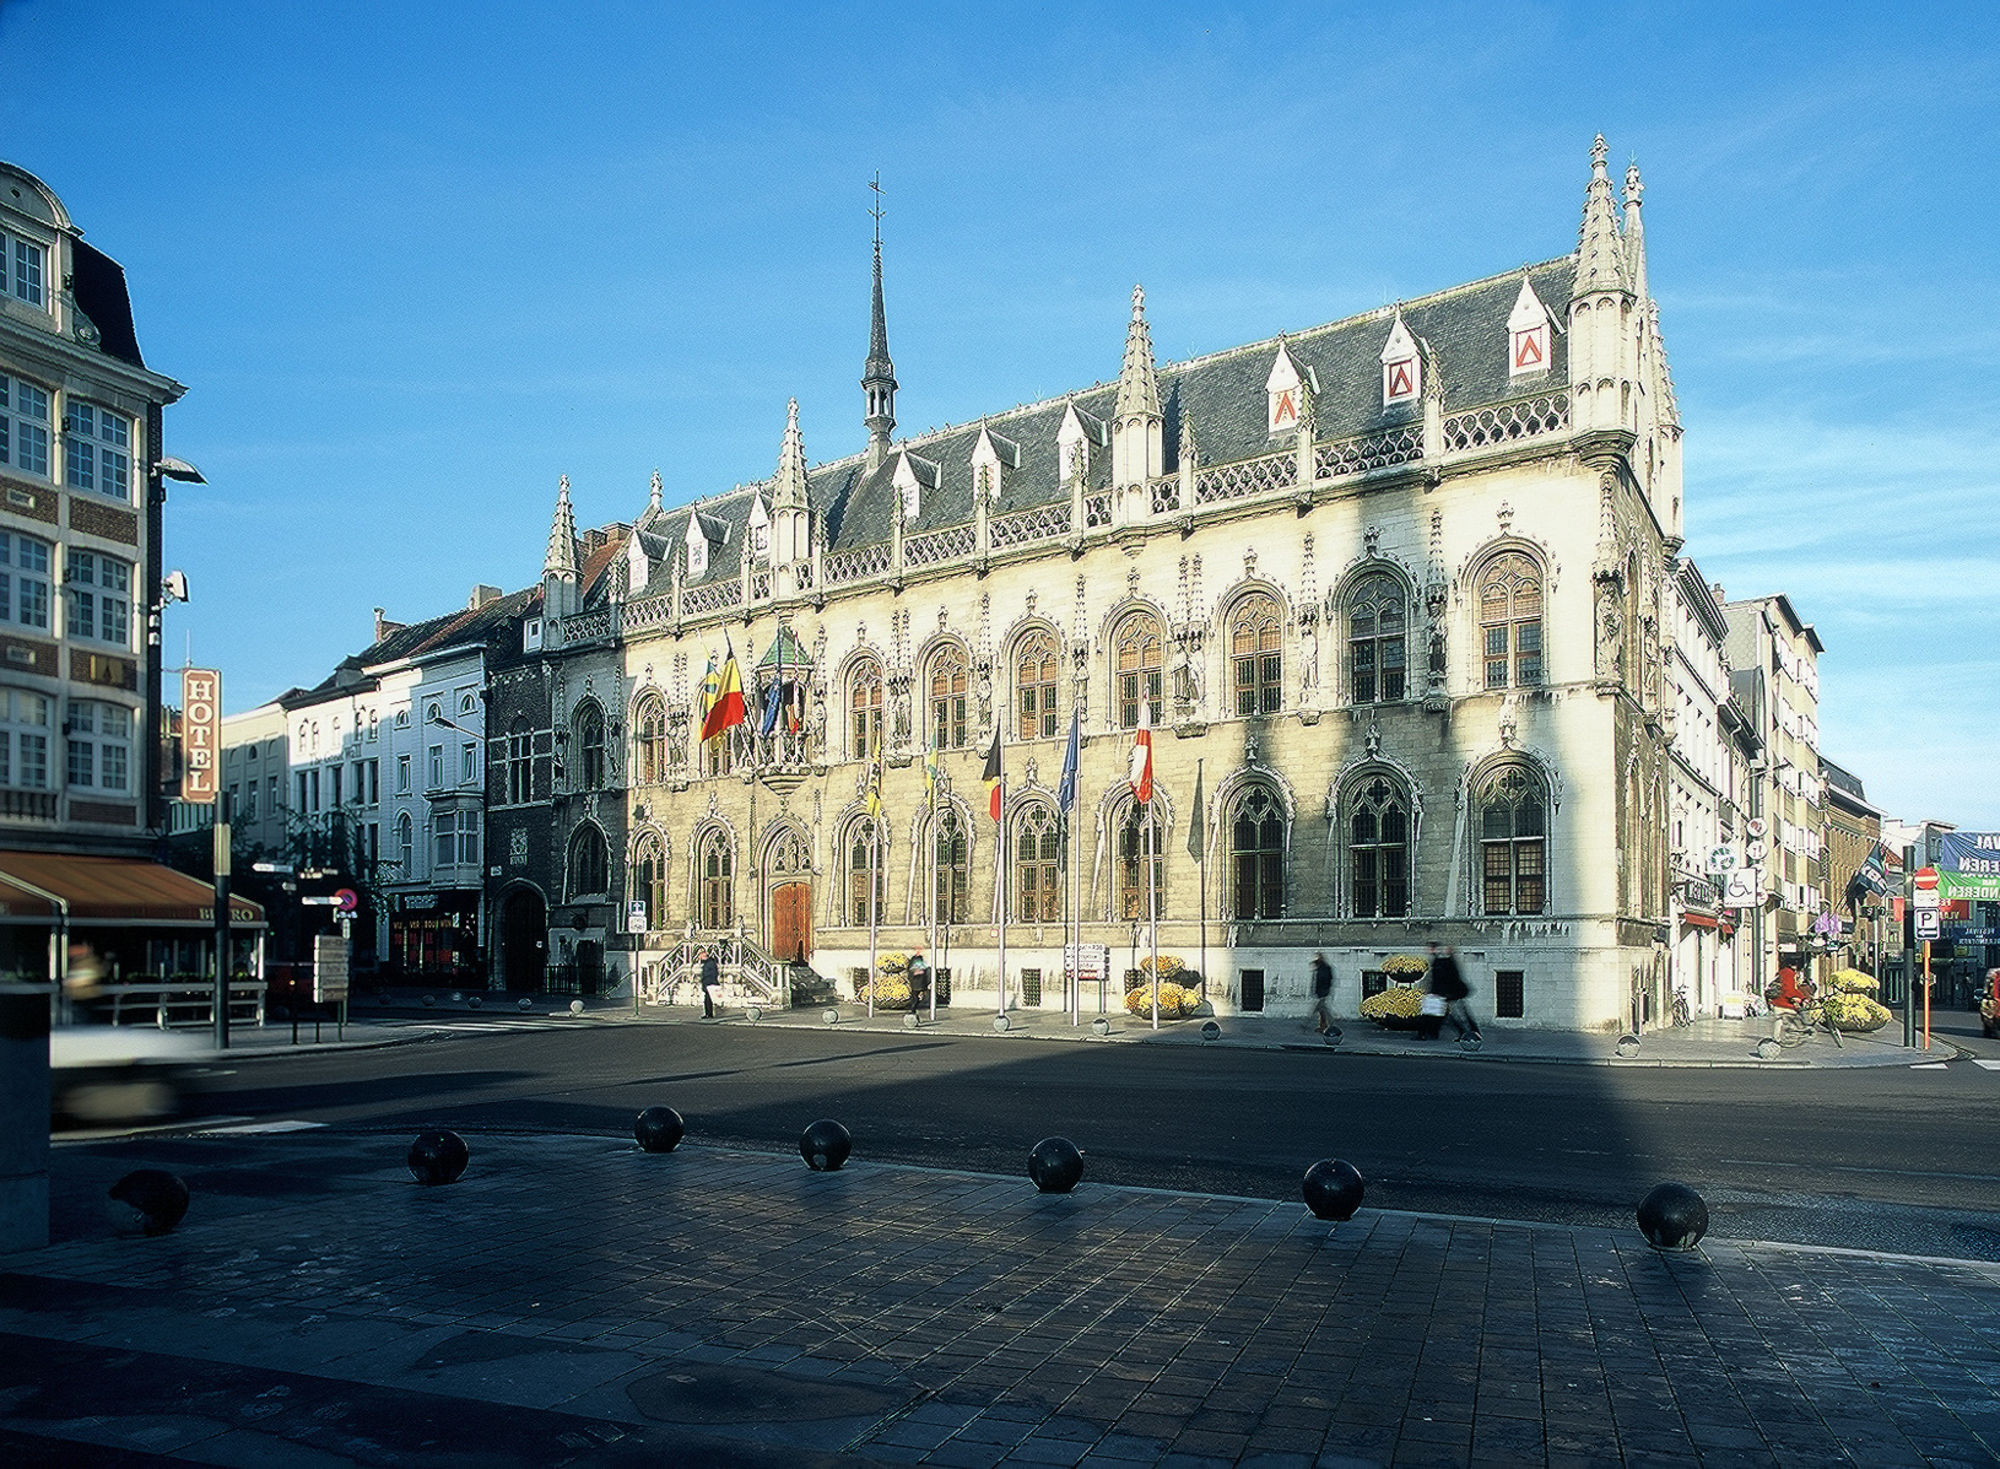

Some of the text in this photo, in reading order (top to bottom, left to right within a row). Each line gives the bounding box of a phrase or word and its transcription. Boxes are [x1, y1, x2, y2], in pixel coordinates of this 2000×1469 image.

[188, 680, 213, 791] HOTEL
[200, 908, 253, 921] BIRO
[1921, 913, 1932, 926] P
